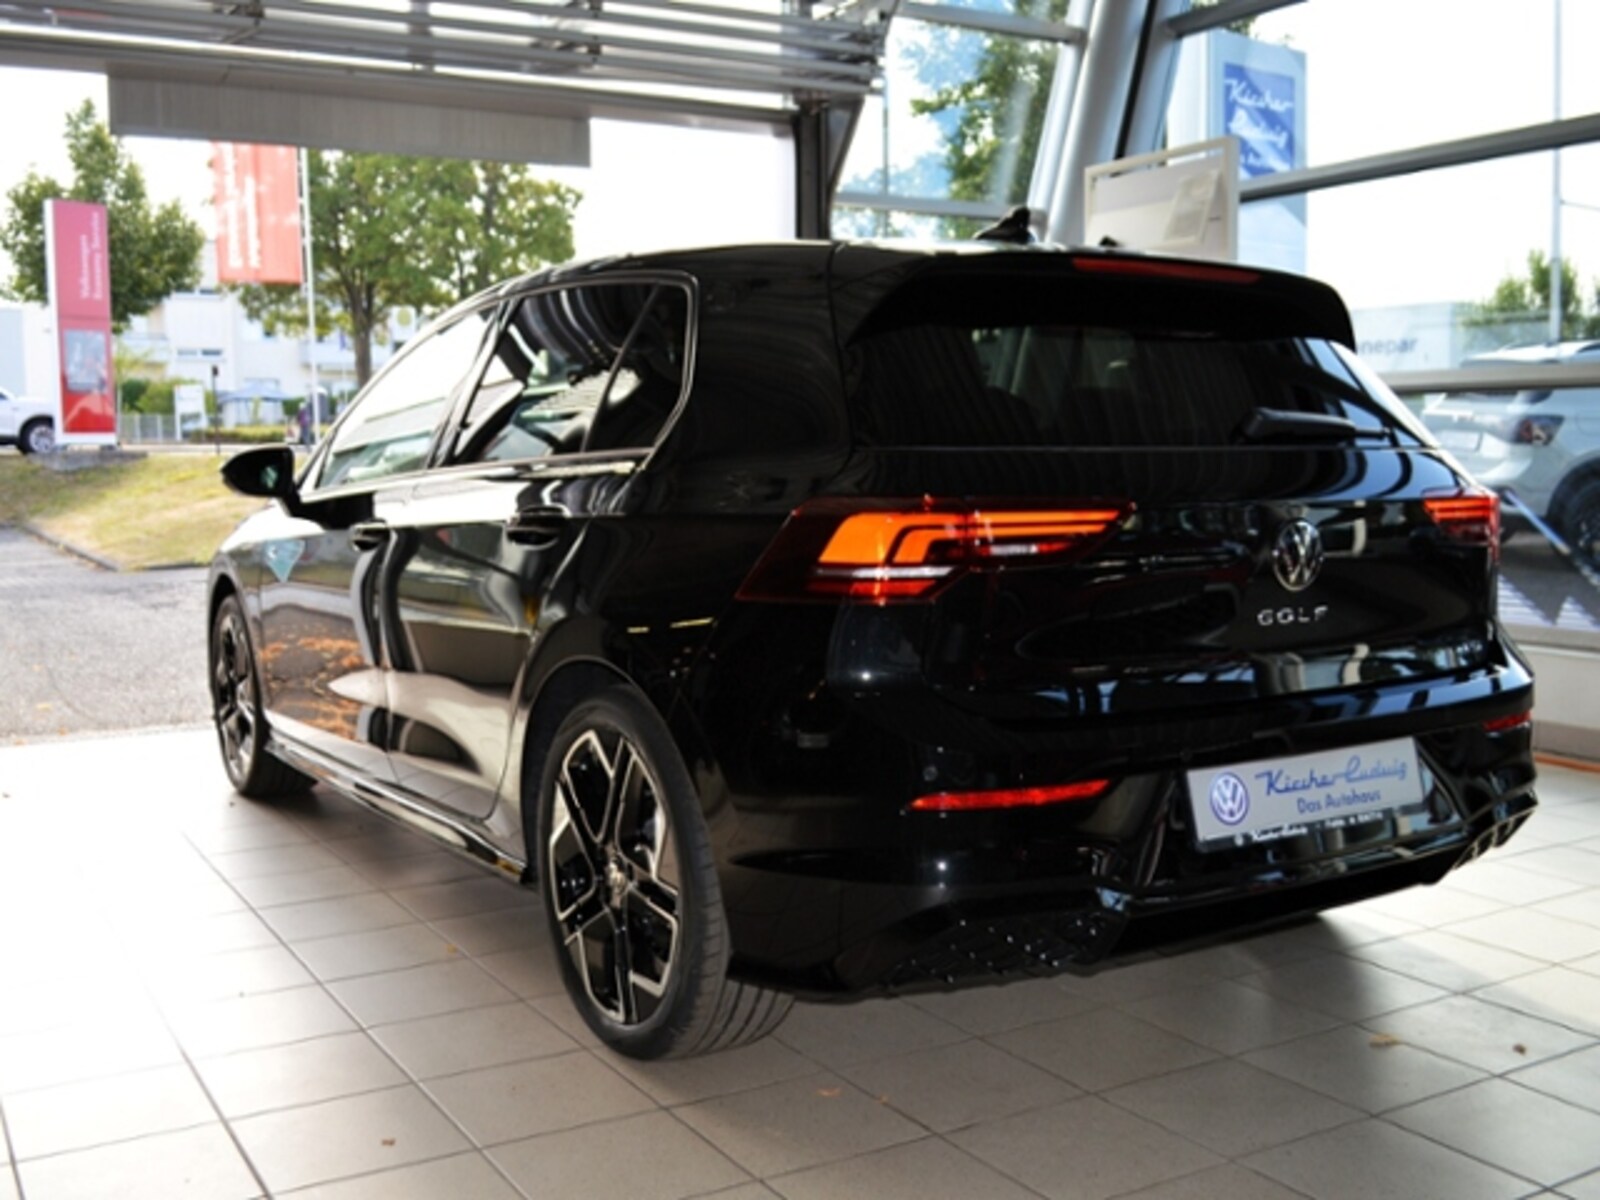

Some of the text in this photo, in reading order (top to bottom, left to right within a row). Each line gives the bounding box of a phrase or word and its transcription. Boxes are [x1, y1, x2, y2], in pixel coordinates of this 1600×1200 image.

[1358, 339, 1418, 358] nepar
[1257, 605, 1329, 626] GOLF
[1297, 789, 1382, 815] Das Autohaus
